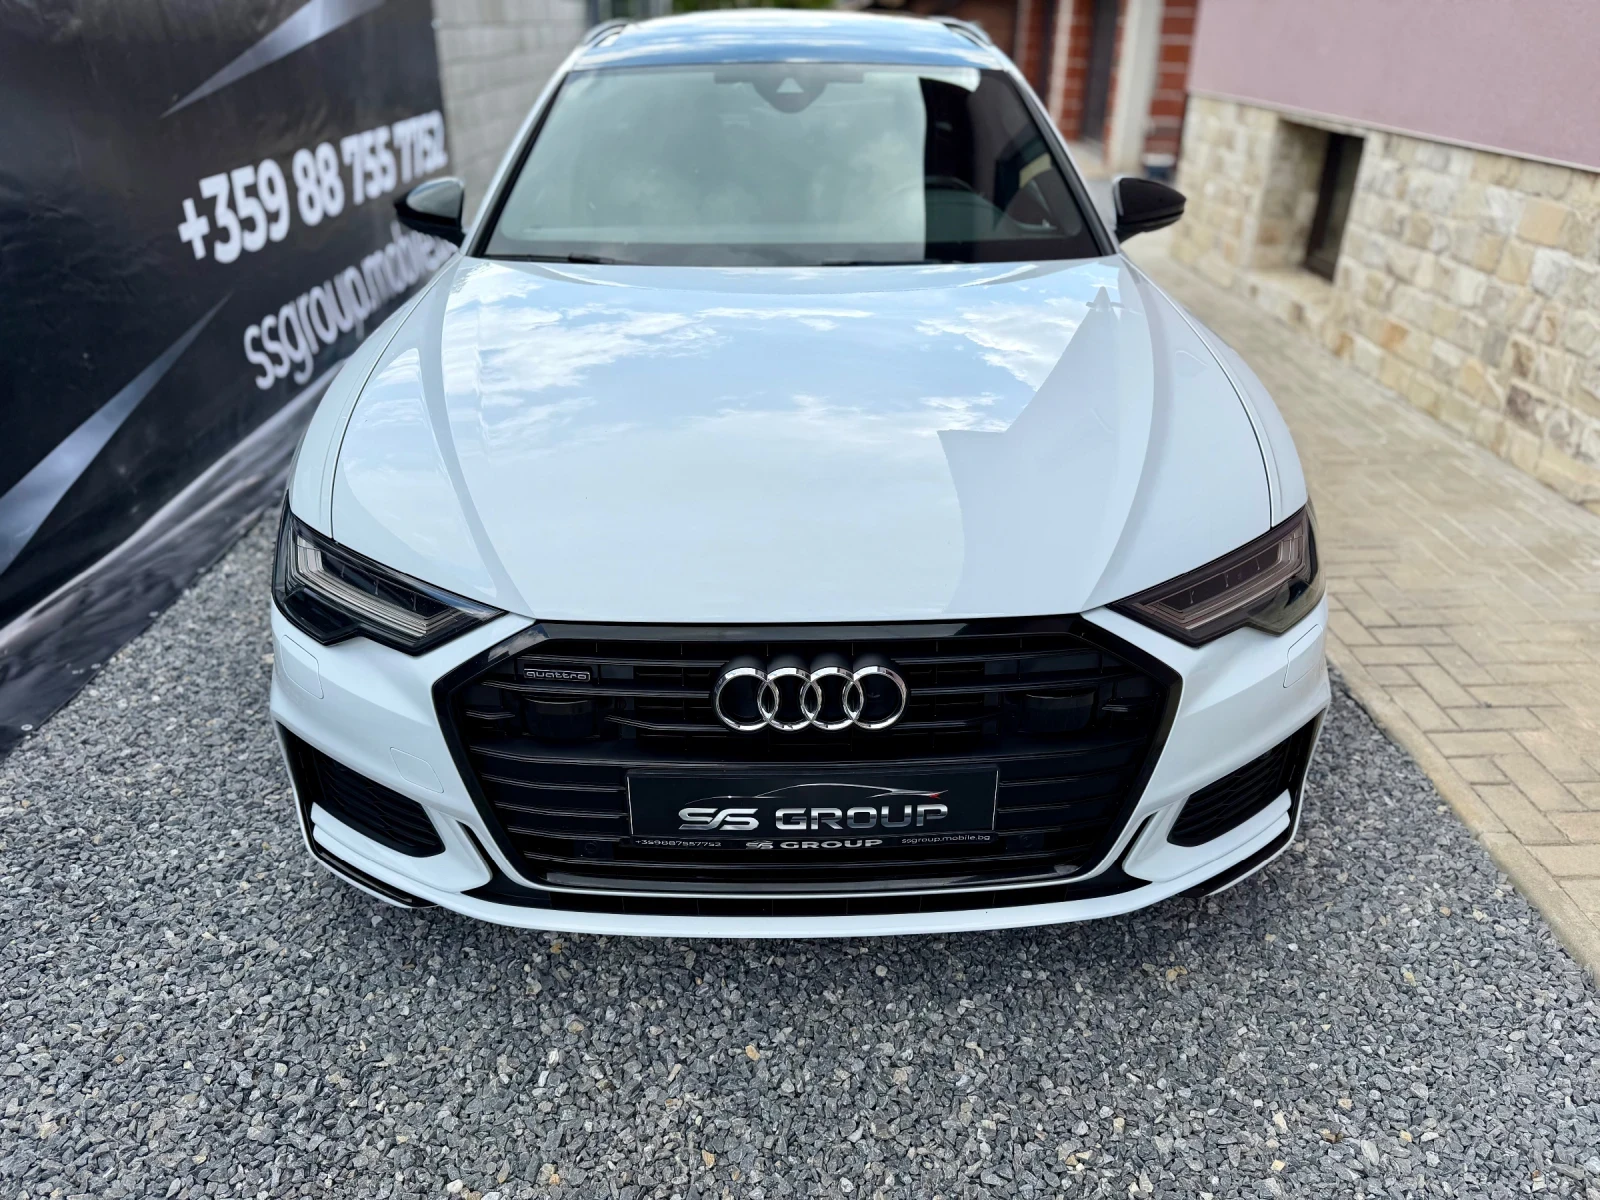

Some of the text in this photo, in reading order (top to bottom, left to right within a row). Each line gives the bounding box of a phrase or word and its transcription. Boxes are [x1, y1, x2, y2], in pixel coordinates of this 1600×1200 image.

[178, 158, 290, 263] +359
[292, 142, 345, 226] 88
[340, 125, 397, 205] 755
[526, 671, 587, 680] quattro
[775, 803, 949, 830] GROUP
[780, 839, 883, 849] GROUP
[901, 834, 991, 844] ssgroup.mobile.bg
